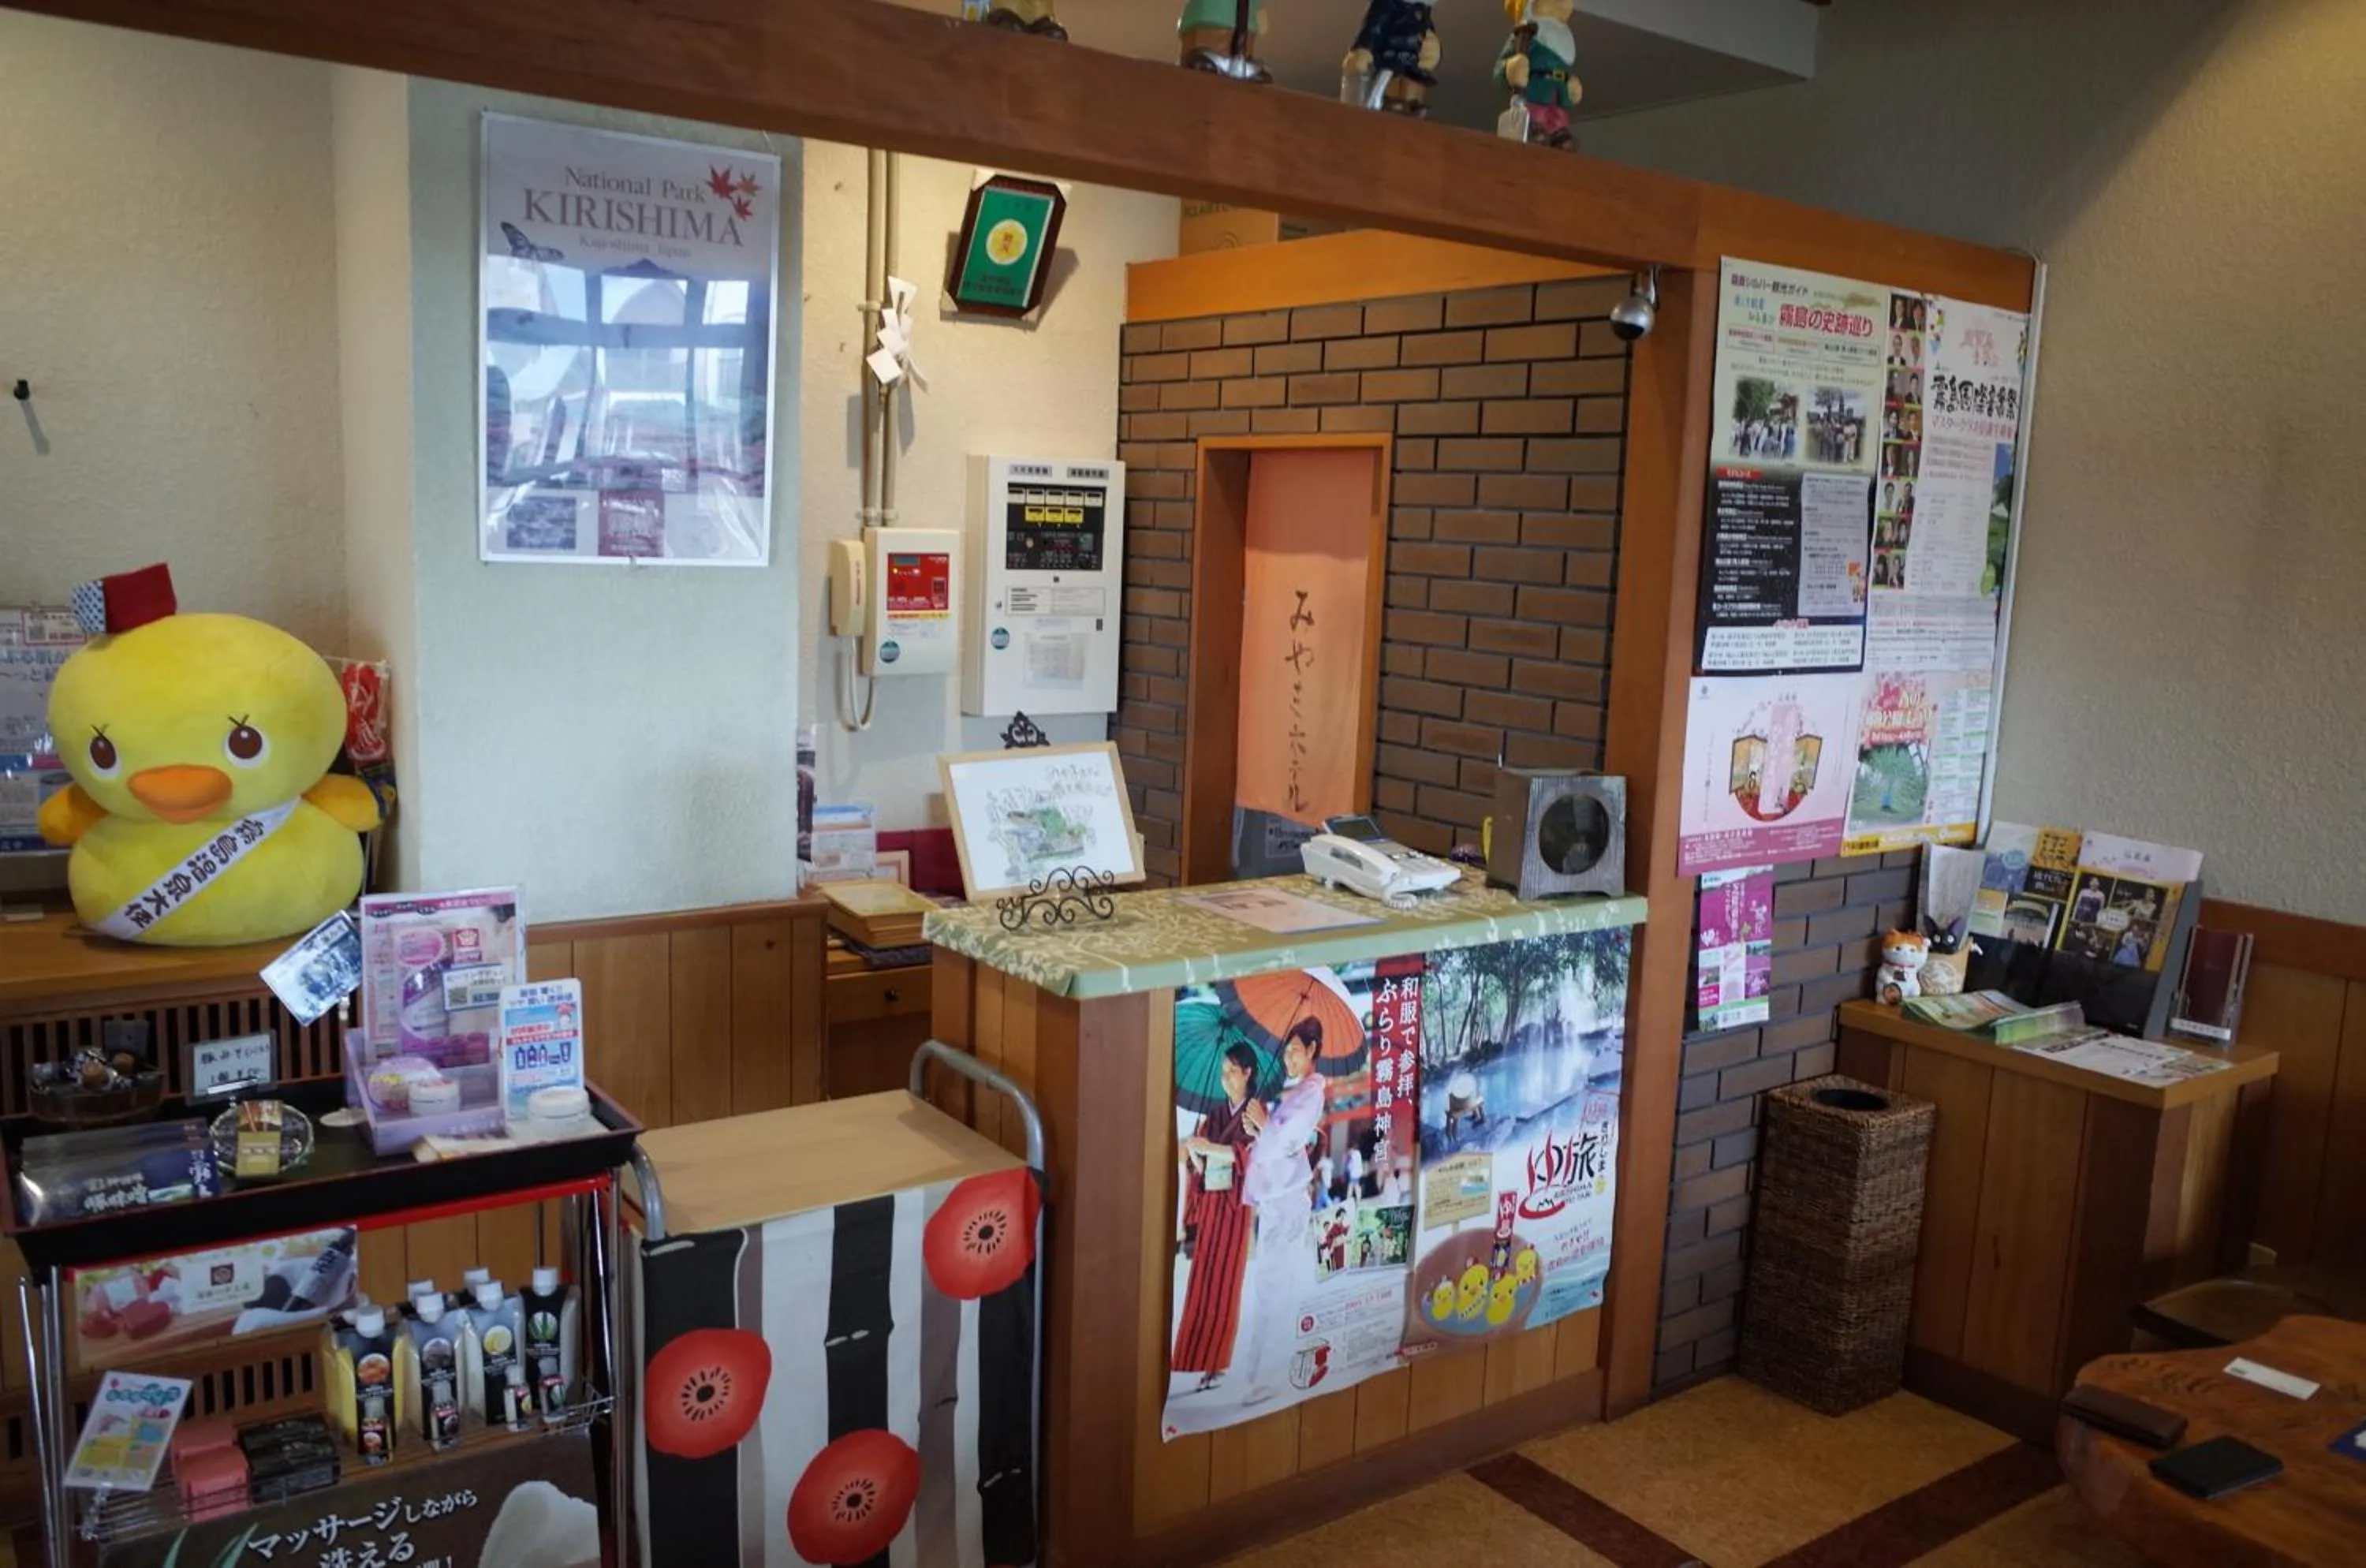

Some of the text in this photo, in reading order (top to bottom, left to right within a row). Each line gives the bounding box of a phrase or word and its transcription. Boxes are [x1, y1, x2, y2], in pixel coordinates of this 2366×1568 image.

[565, 166, 707, 203] National Park
[522, 189, 745, 248] KIRISHIMA
[1779, 303, 1874, 338] 霧島の史跡巡り
[123, 819, 265, 929] 霧島温泉大使
[1396, 977, 1419, 1106] 和服で参拝、
[248, 1489, 478, 1559] マッサージしながら
[319, 1531, 416, 1568] 洗える
